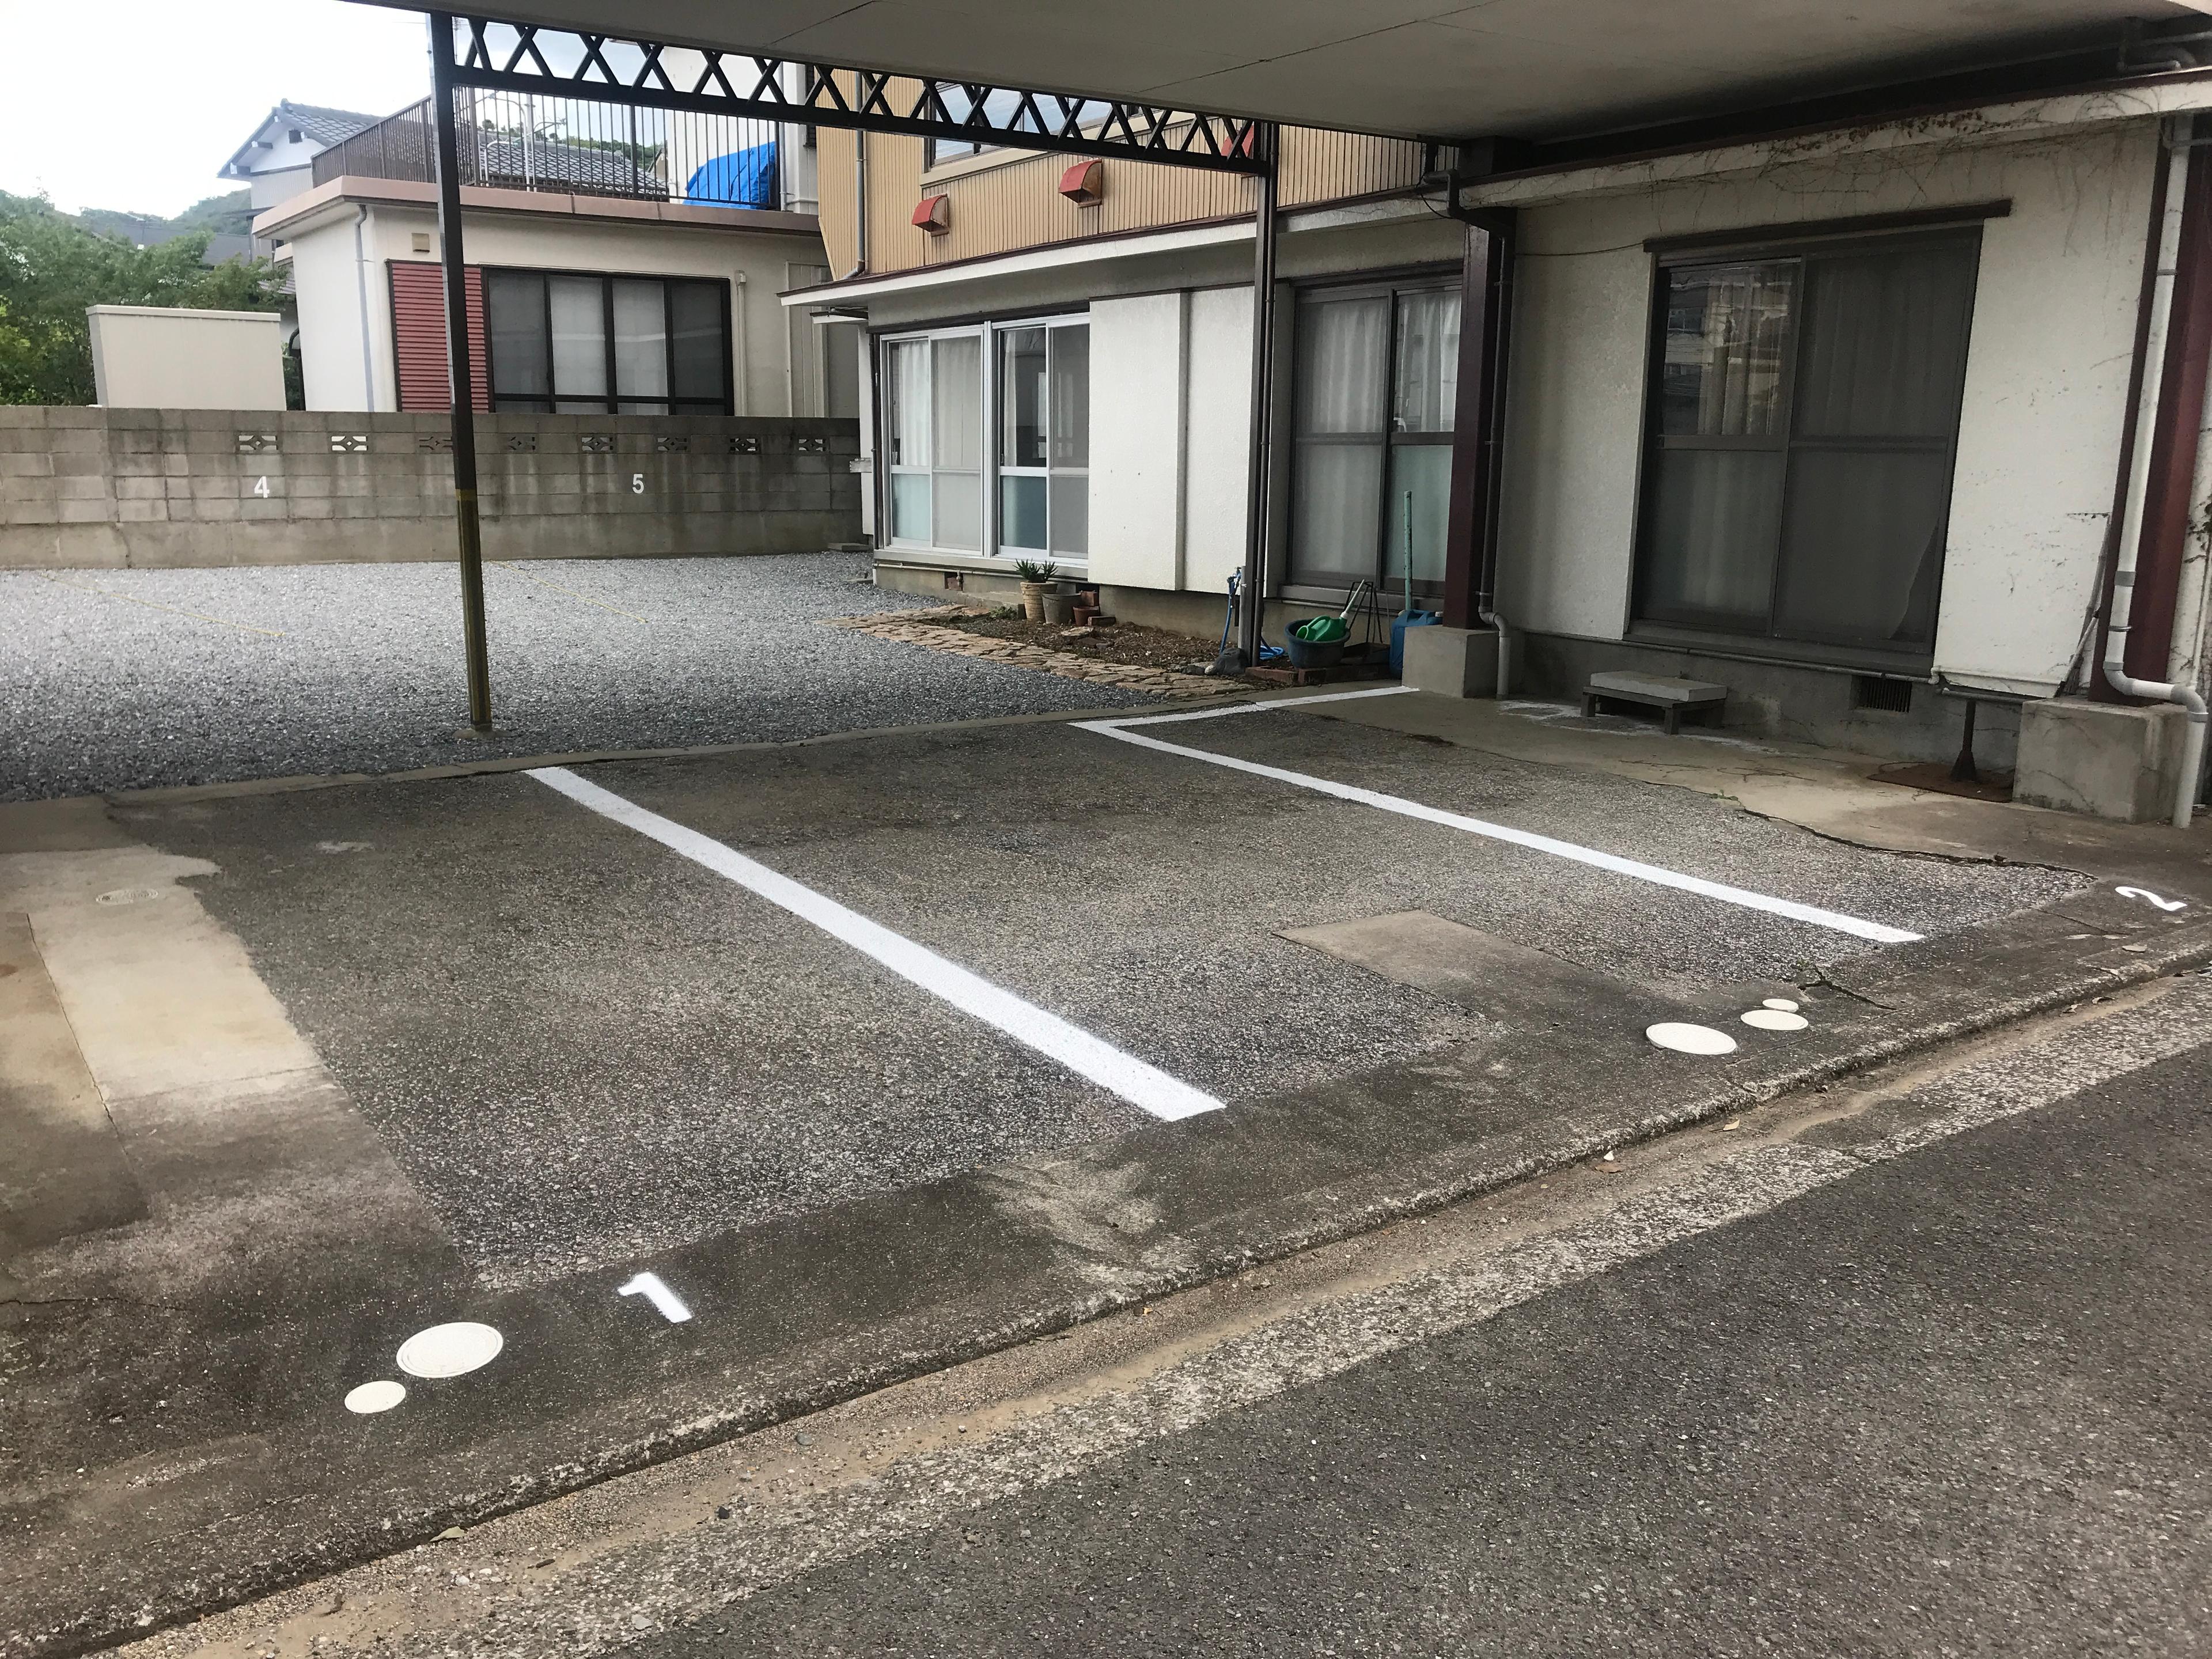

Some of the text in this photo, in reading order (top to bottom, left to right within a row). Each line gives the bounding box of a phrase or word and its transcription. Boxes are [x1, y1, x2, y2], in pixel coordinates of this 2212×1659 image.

[254, 476, 270, 498] 4
[632, 474, 644, 494] 5
[2115, 886, 2188, 911] 2
[618, 1272, 692, 1323] 1
